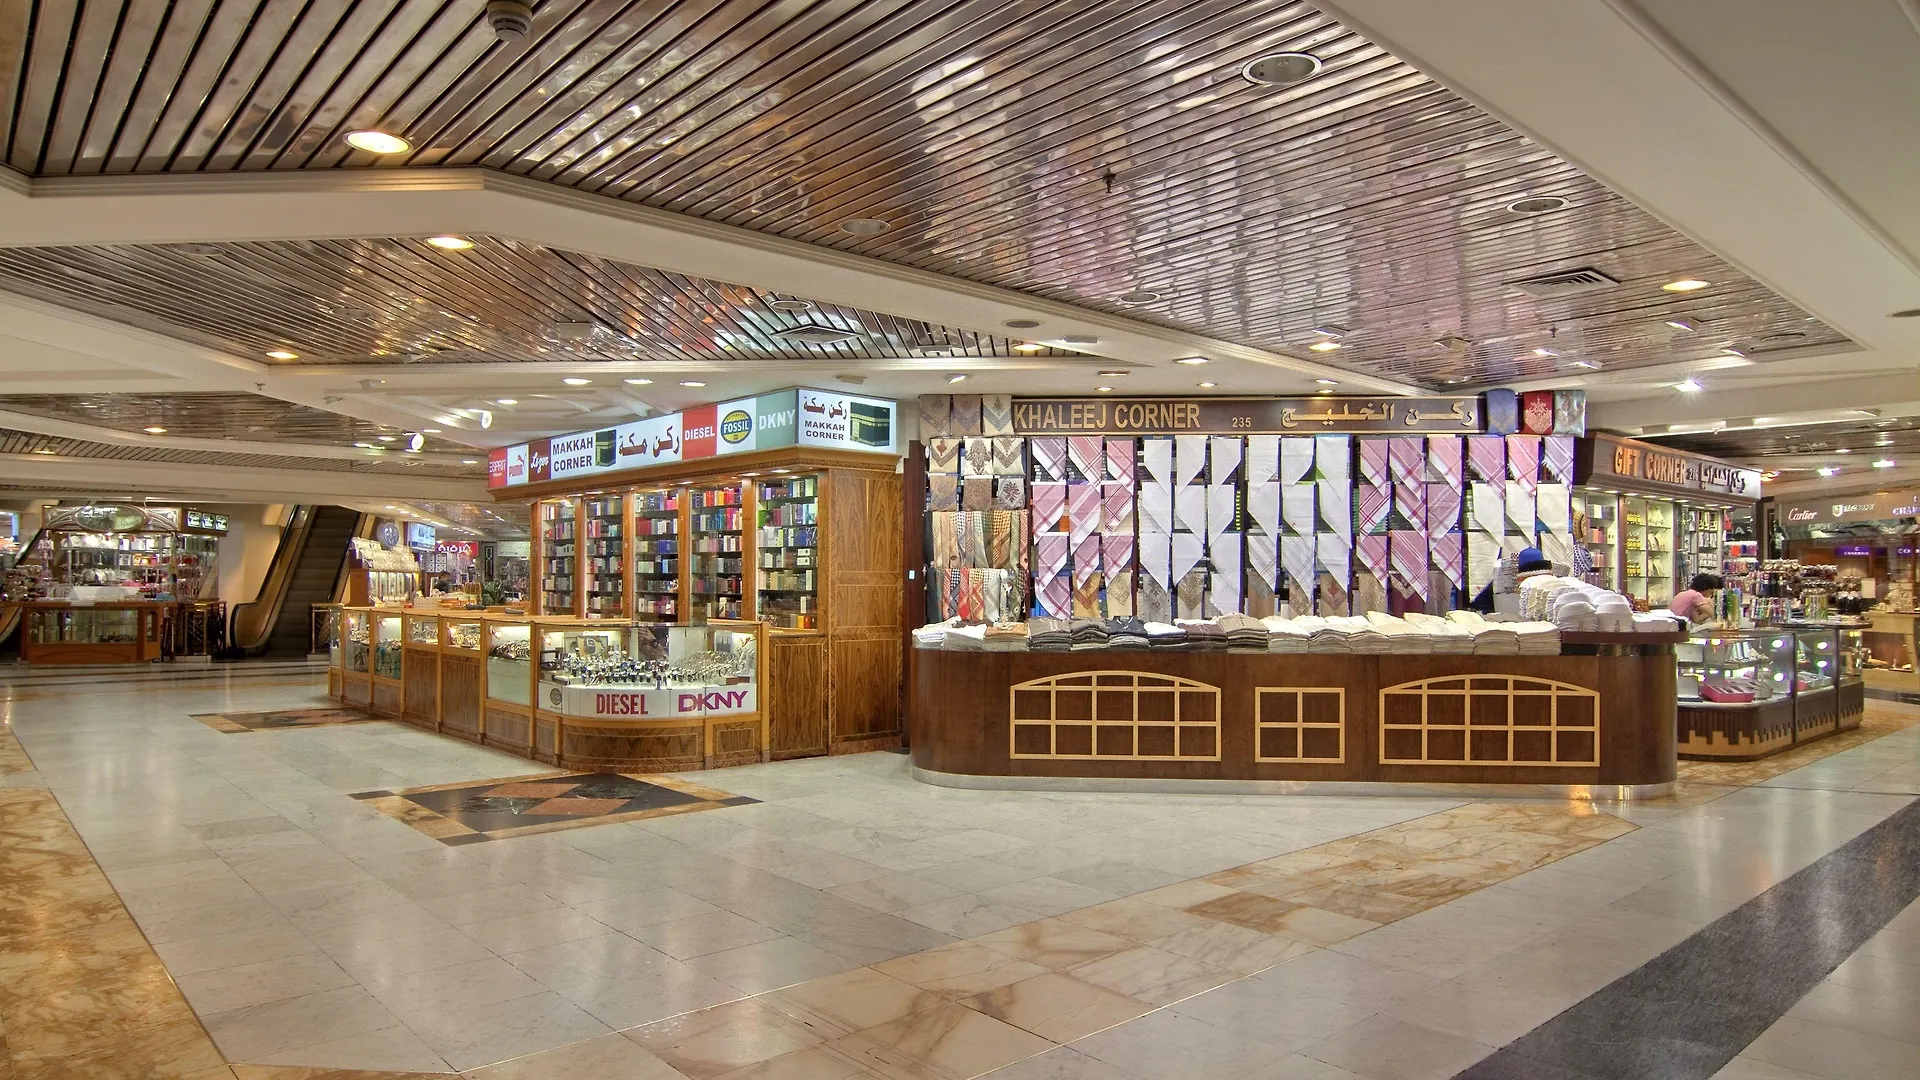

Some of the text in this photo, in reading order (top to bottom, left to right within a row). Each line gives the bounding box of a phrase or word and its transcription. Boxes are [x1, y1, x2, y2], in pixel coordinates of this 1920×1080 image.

[803, 396, 848, 420] ركن مكة
[1014, 404, 1252, 429] KHALEEJ CORNER 235
[1281, 401, 1476, 428] ركن الخليج
[723, 419, 750, 435] FOSSIL
[758, 409, 796, 430] DKNY
[804, 420, 845, 431] MAKKAH
[618, 425, 680, 458] ركن مكة
[684, 426, 715, 441] DIESEL
[805, 430, 844, 441] CORNER
[552, 436, 594, 456] MAKKAH
[489, 459, 507, 473] ESPRIT
[553, 455, 593, 472] CORNER
[1614, 445, 1640, 477] GIFT
[1645, 451, 1687, 484] CORNER
[1788, 508, 1818, 521] Cartier
[596, 693, 649, 715] DIESEL
[678, 690, 749, 713] DKNY
